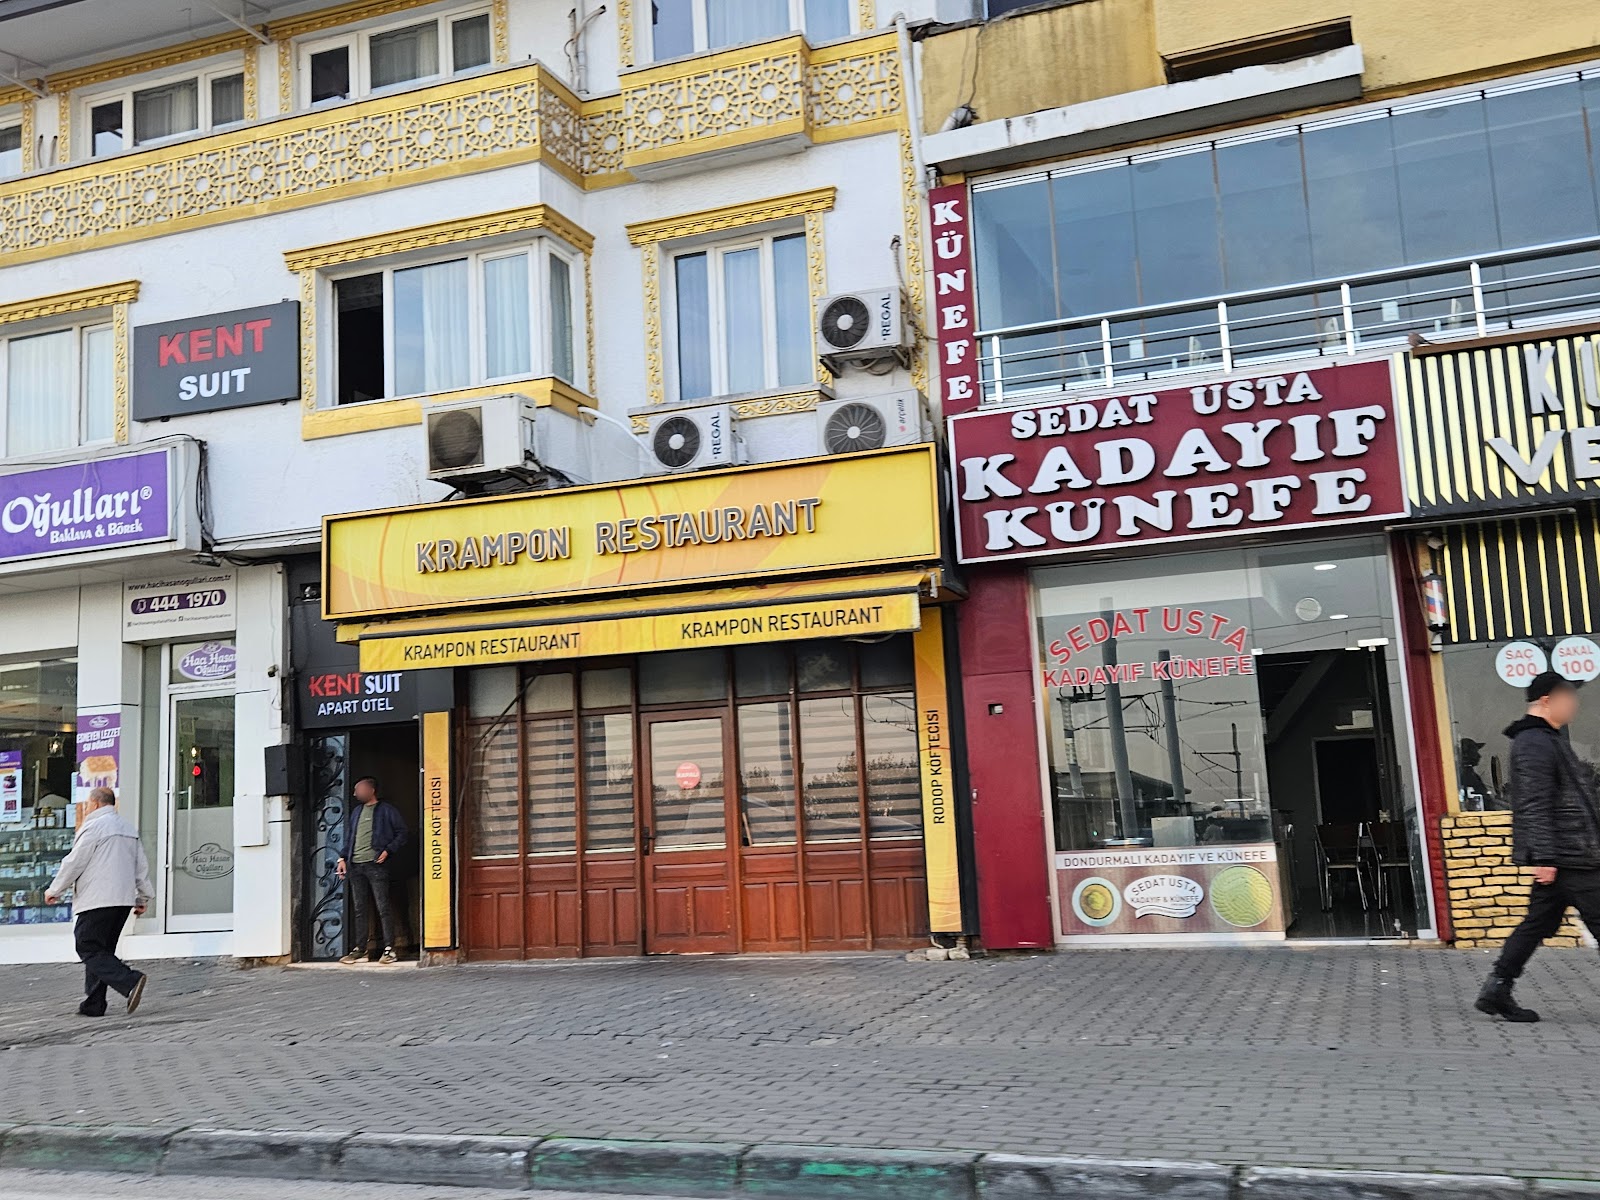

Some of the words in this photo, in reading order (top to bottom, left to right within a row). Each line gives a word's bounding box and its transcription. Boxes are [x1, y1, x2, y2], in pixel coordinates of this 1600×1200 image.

[880, 293, 891, 337] REGAL
[932, 199, 973, 401] KÜNEFE
[158, 318, 272, 368] KENT
[179, 367, 251, 401] SUIT
[1010, 393, 1158, 440] SEDAT
[1190, 371, 1323, 416] USTA
[710, 411, 721, 456] REGAL
[959, 404, 1387, 502] KADAYIF
[982, 467, 1372, 551] KÜNEFE
[95, 524, 105, 538] &
[415, 525, 570, 575] KRAMPON
[595, 496, 822, 555] RESTAURANT
[150, 595, 179, 611] 444
[186, 590, 221, 608] 1970
[681, 615, 763, 640] KRAMPON
[768, 606, 883, 633] RESTAURANT
[1049, 607, 1150, 666] SEDAT
[1161, 607, 1248, 654] USTA
[404, 641, 475, 661] KRAMPON
[480, 632, 581, 656] RESTAURANT
[1558, 645, 1594, 657] SAKAL
[1043, 662, 1145, 688] KADAYIF
[1151, 654, 1255, 682] KÜNEFE
[1505, 662, 1537, 677] 200
[1561, 659, 1595, 675] 100
[308, 672, 362, 697] KENT
[364, 673, 402, 695] SUIT
[317, 700, 359, 716] APART
[361, 697, 394, 713] OTEL
[923, 709, 942, 776] KÖFTECİSİ
[931, 779, 945, 824] RODOP
[431, 839, 442, 880] RODOP
[1064, 856, 1141, 868] DONDURMALI
[1145, 853, 1193, 864] KADAYIF
[1198, 852, 1213, 862] VE
[1217, 849, 1267, 862] KÜNEFE
[1132, 877, 1165, 896] SEDAT
[1168, 877, 1196, 894] USTA
